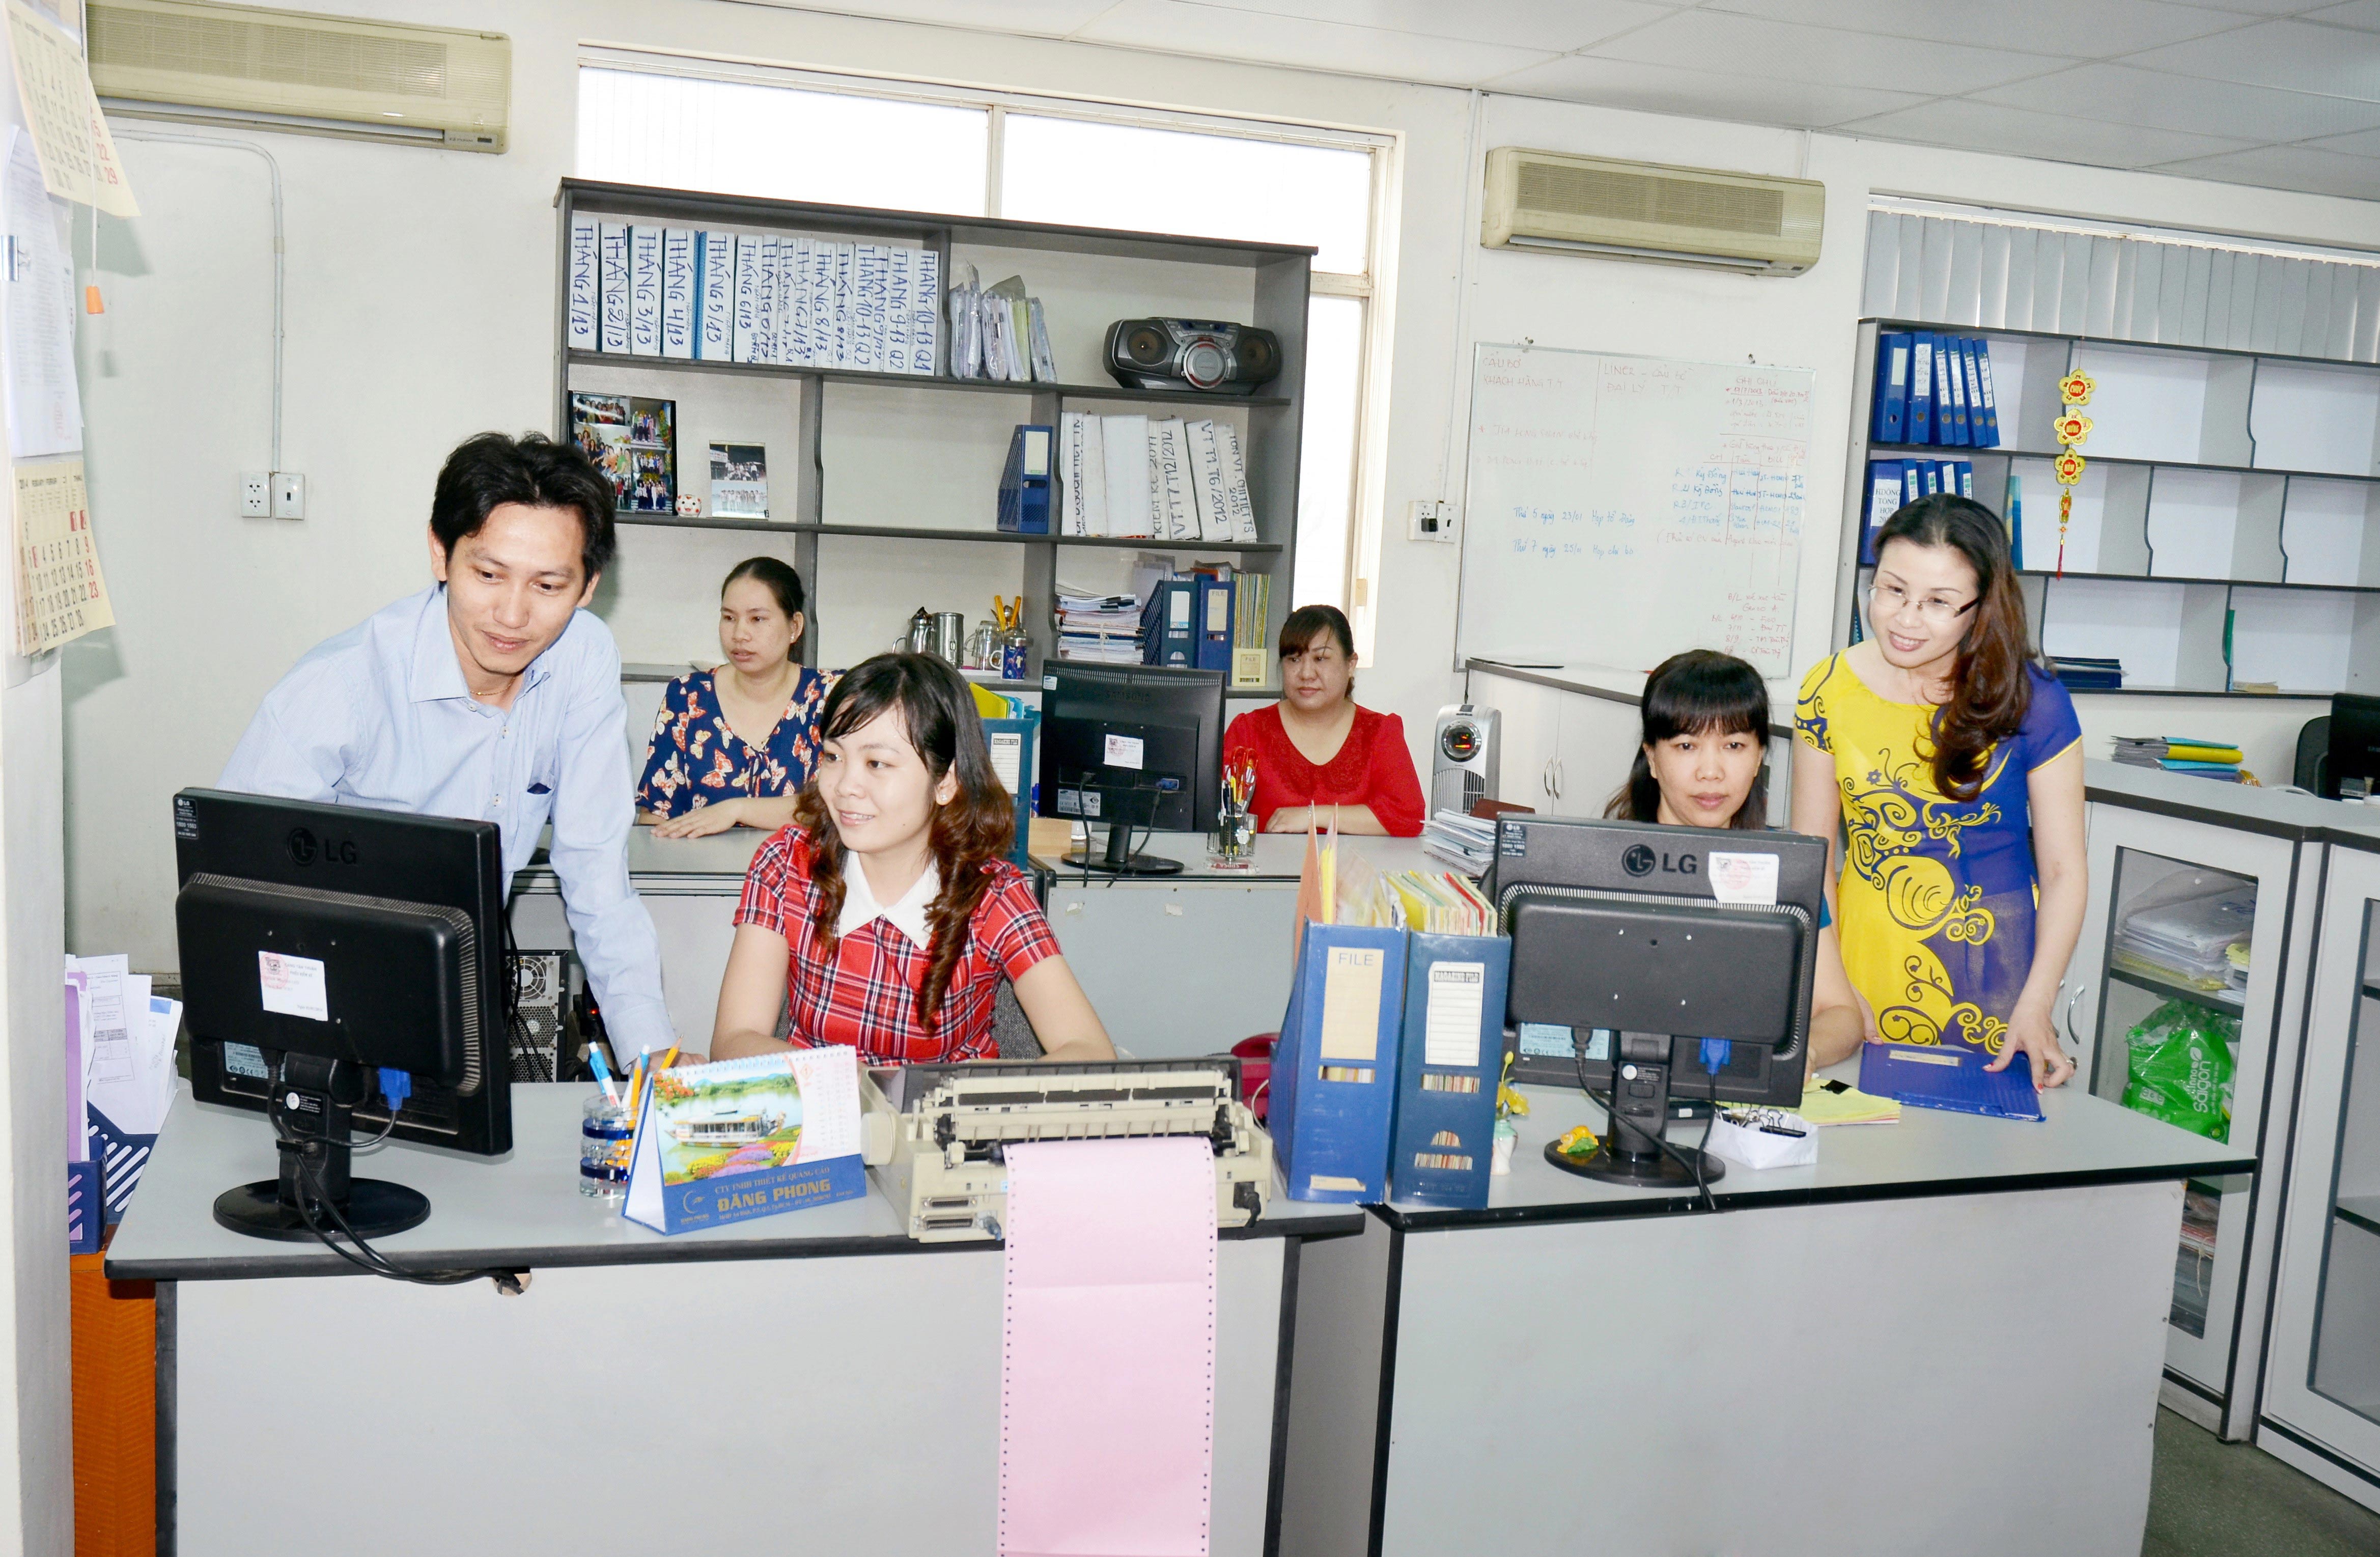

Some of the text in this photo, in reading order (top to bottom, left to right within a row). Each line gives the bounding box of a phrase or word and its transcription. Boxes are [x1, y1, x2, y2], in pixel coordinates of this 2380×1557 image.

[572, 224, 597, 335] THÁNG 1/13
[604, 229, 629, 346] THÁNG 2/13
[635, 232, 661, 344] THÁNG 3/13
[666, 231, 693, 345] THÁNG 4/13
[706, 235, 731, 342] THÁNG 5/13
[739, 240, 759, 329] THÁNG 6/13
[762, 238, 779, 313] THÁNG
[794, 246, 814, 355] THÁNG 7/13
[814, 249, 836, 350] THÁNG 8/13
[835, 249, 852, 361] THÁNG 8/13
[856, 299, 873, 338] 10-13
[889, 251, 912, 369] THÁNG 9-13 Q2
[916, 305, 935, 345] 10-13
[854, 342, 870, 365] Q2
[914, 349, 932, 371] Q1
[1201, 423, 1214, 443] VT
[1229, 487, 1240, 516] 2012
[1533, 508, 1538, 518] 5
[1561, 511, 1582, 522] 23/01
[85, 536, 90, 553] 9
[1532, 540, 1537, 551] 7
[1564, 543, 1582, 554] 25/01
[85, 559, 94, 576] 16
[89, 581, 99, 599] 23
[325, 839, 357, 865] LG
[1662, 853, 1697, 875] LG
[1338, 953, 1374, 967] FILE
[2193, 1061, 2211, 1113] Saigon
[718, 1191, 767, 1212] ĐĂNG
[773, 1179, 831, 1201] PHONG
